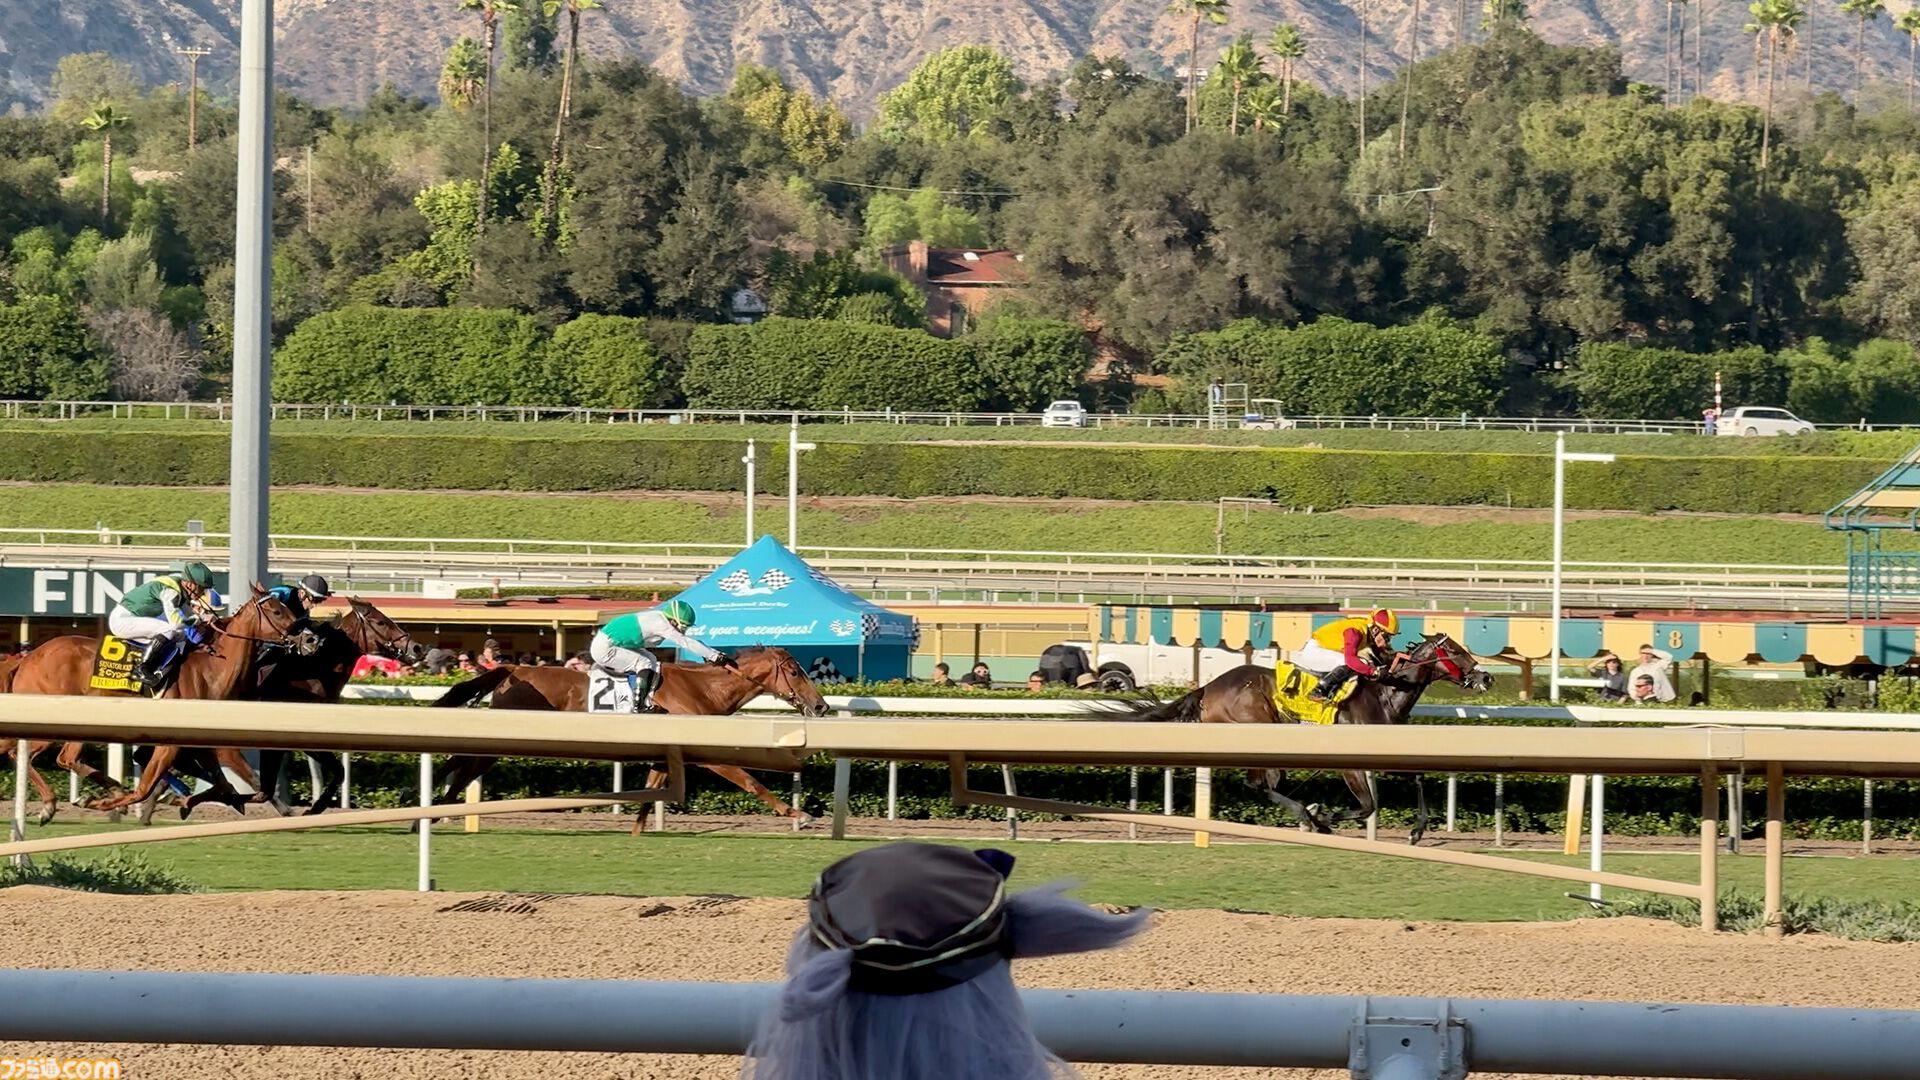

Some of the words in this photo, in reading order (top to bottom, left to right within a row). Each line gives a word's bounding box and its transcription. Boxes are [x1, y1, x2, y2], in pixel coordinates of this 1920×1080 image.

[684, 624, 706, 636] art
[709, 625, 740, 640] your
[1668, 630, 1683, 649] 8
[101, 635, 126, 661] 6
[593, 677, 615, 711] 2
